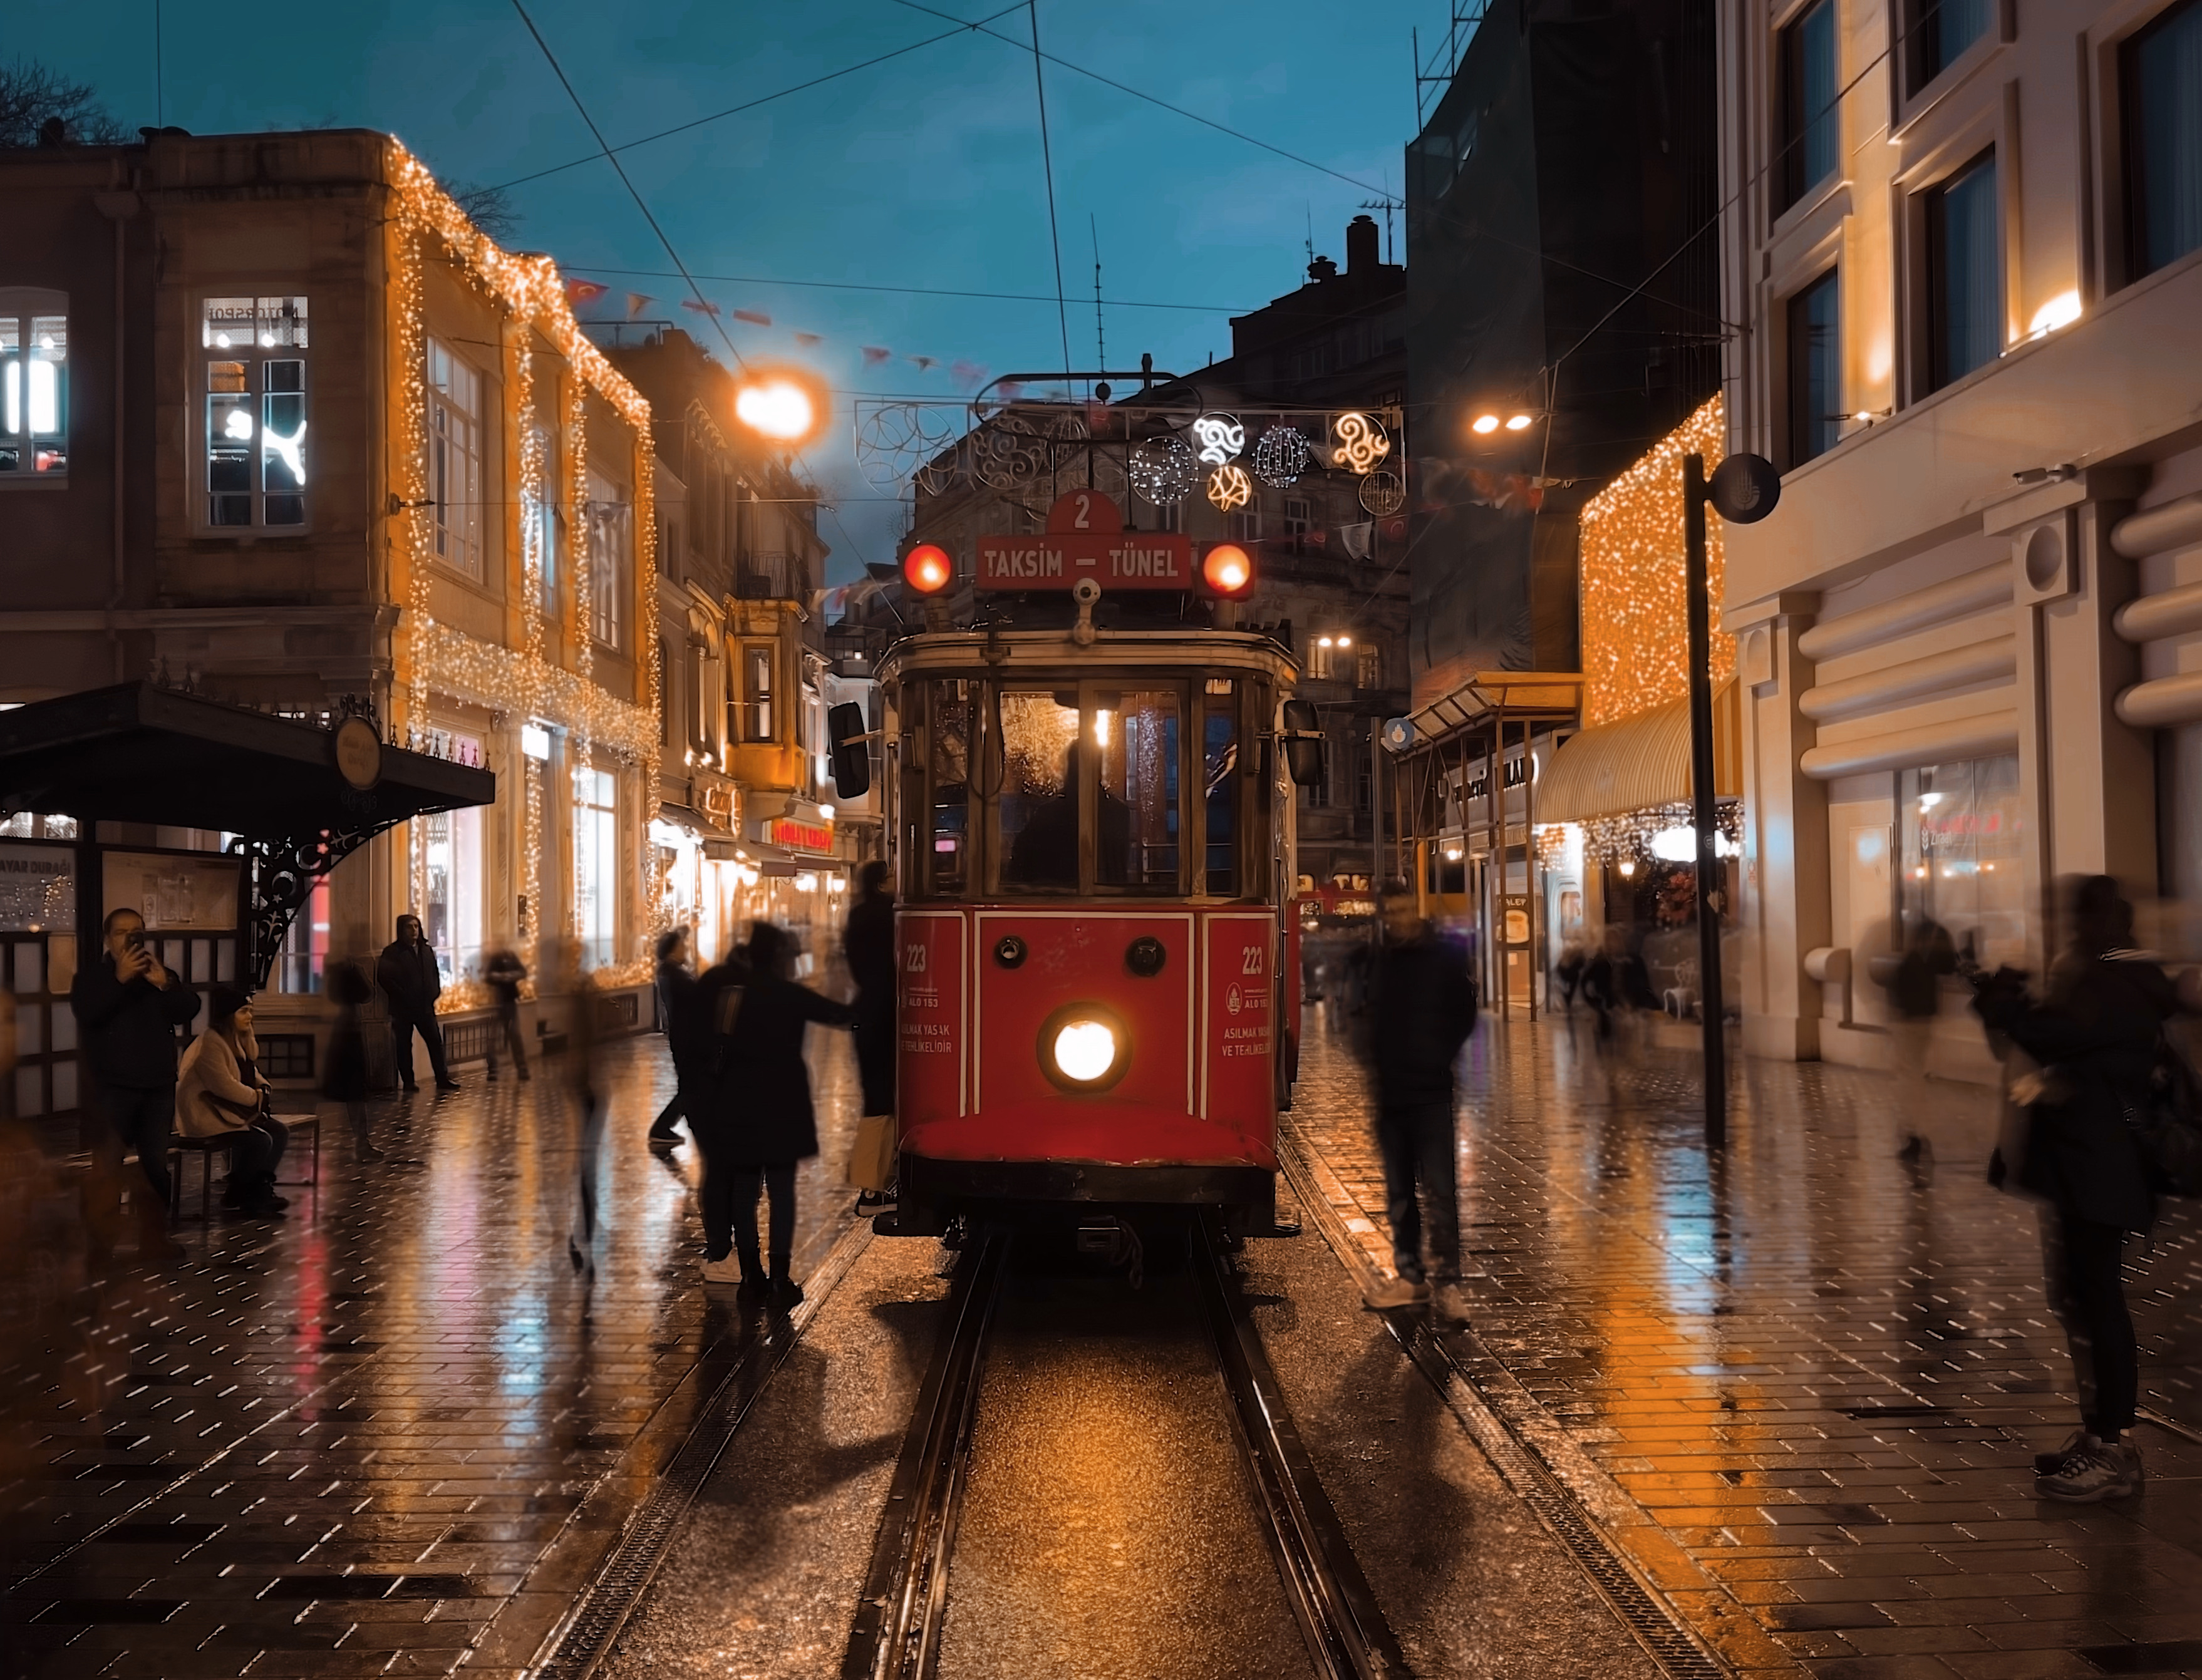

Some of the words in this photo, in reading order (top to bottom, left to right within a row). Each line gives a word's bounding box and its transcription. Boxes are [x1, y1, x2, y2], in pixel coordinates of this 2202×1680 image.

[1075, 495, 1090, 528] 2
[985, 543, 1062, 577] TAKSİM
[1109, 542, 1178, 577] TÜNEL
[30, 858, 70, 874] DURAĞI
[907, 944, 926, 972] 223
[1243, 946, 1263, 974] 223
[909, 997, 921, 1007] ALO
[924, 998, 938, 1007] 153
[1244, 999, 1259, 1008] ALO
[901, 1024, 923, 1035] ILMAK
[923, 1024, 949, 1036] YASAK
[1224, 1027, 1257, 1039] ASILMAK
[1222, 1045, 1233, 1056] VE
